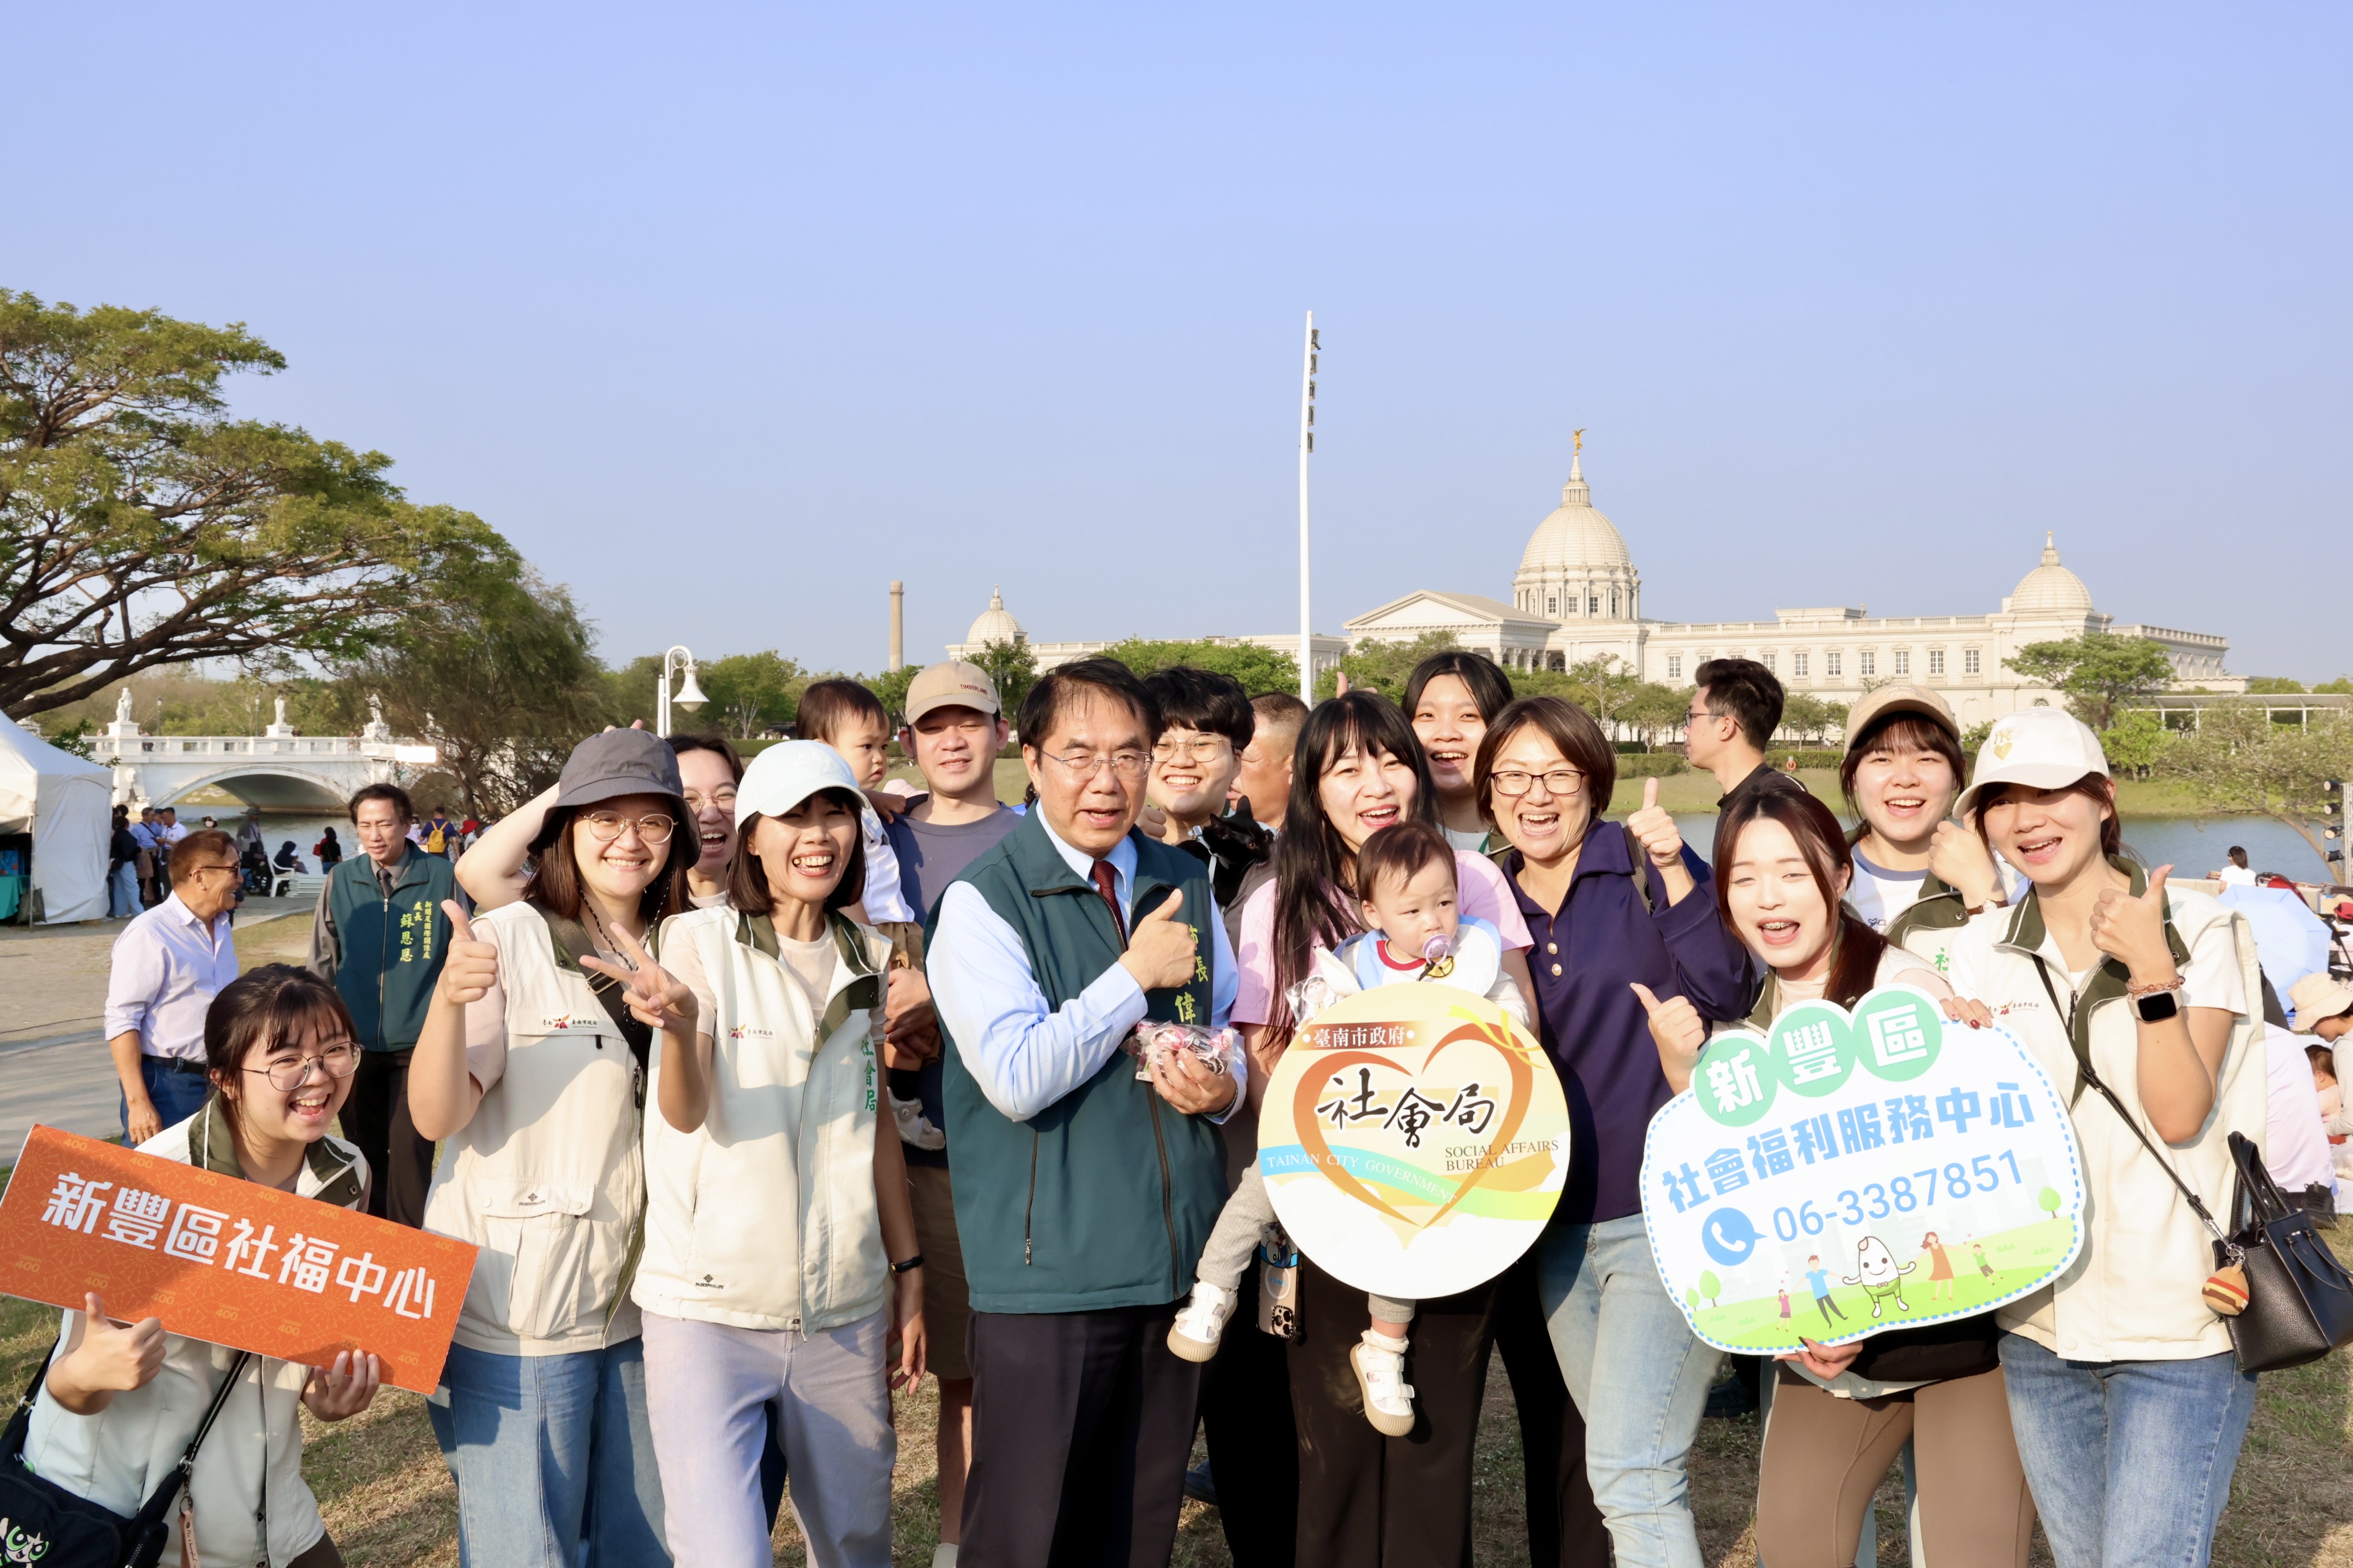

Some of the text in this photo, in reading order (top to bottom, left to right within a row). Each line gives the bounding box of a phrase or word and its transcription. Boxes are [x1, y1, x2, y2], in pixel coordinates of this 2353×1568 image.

[960, 684, 988, 695] TIMBERLAND
[413, 901, 423, 921] 處長
[400, 913, 415, 962] 蘇恩恩
[1314, 1026, 1406, 1048] 臺南市政府
[1705, 1003, 1929, 1115] 新豐區
[1317, 1067, 1495, 1149] 社會局
[63, 1139, 87, 1151] 400
[1445, 1140, 1559, 1158] SOCIAL AFFAIRS
[1662, 1081, 2035, 1214] 社會福利服務中心
[129, 1157, 153, 1169] 400
[1446, 1157, 1505, 1171] BUREAU
[194, 1174, 217, 1186] 400
[1266, 1153, 1457, 1204] TAINAN CITY GOVERNMENT
[257, 1191, 279, 1203] 400
[1772, 1149, 2023, 1242] 06-3387851
[318, 1208, 339, 1220] 400
[376, 1224, 397, 1236] 400
[41, 1172, 436, 1320] 新豐區社福中心
[434, 1240, 454, 1252] 400
[15, 1259, 40, 1273] 400
[84, 1276, 108, 1289] 400
[151, 1292, 175, 1305] 400
[215, 1308, 238, 1321] 400
[278, 1323, 300, 1336] 400
[397, 1354, 419, 1366] 400
